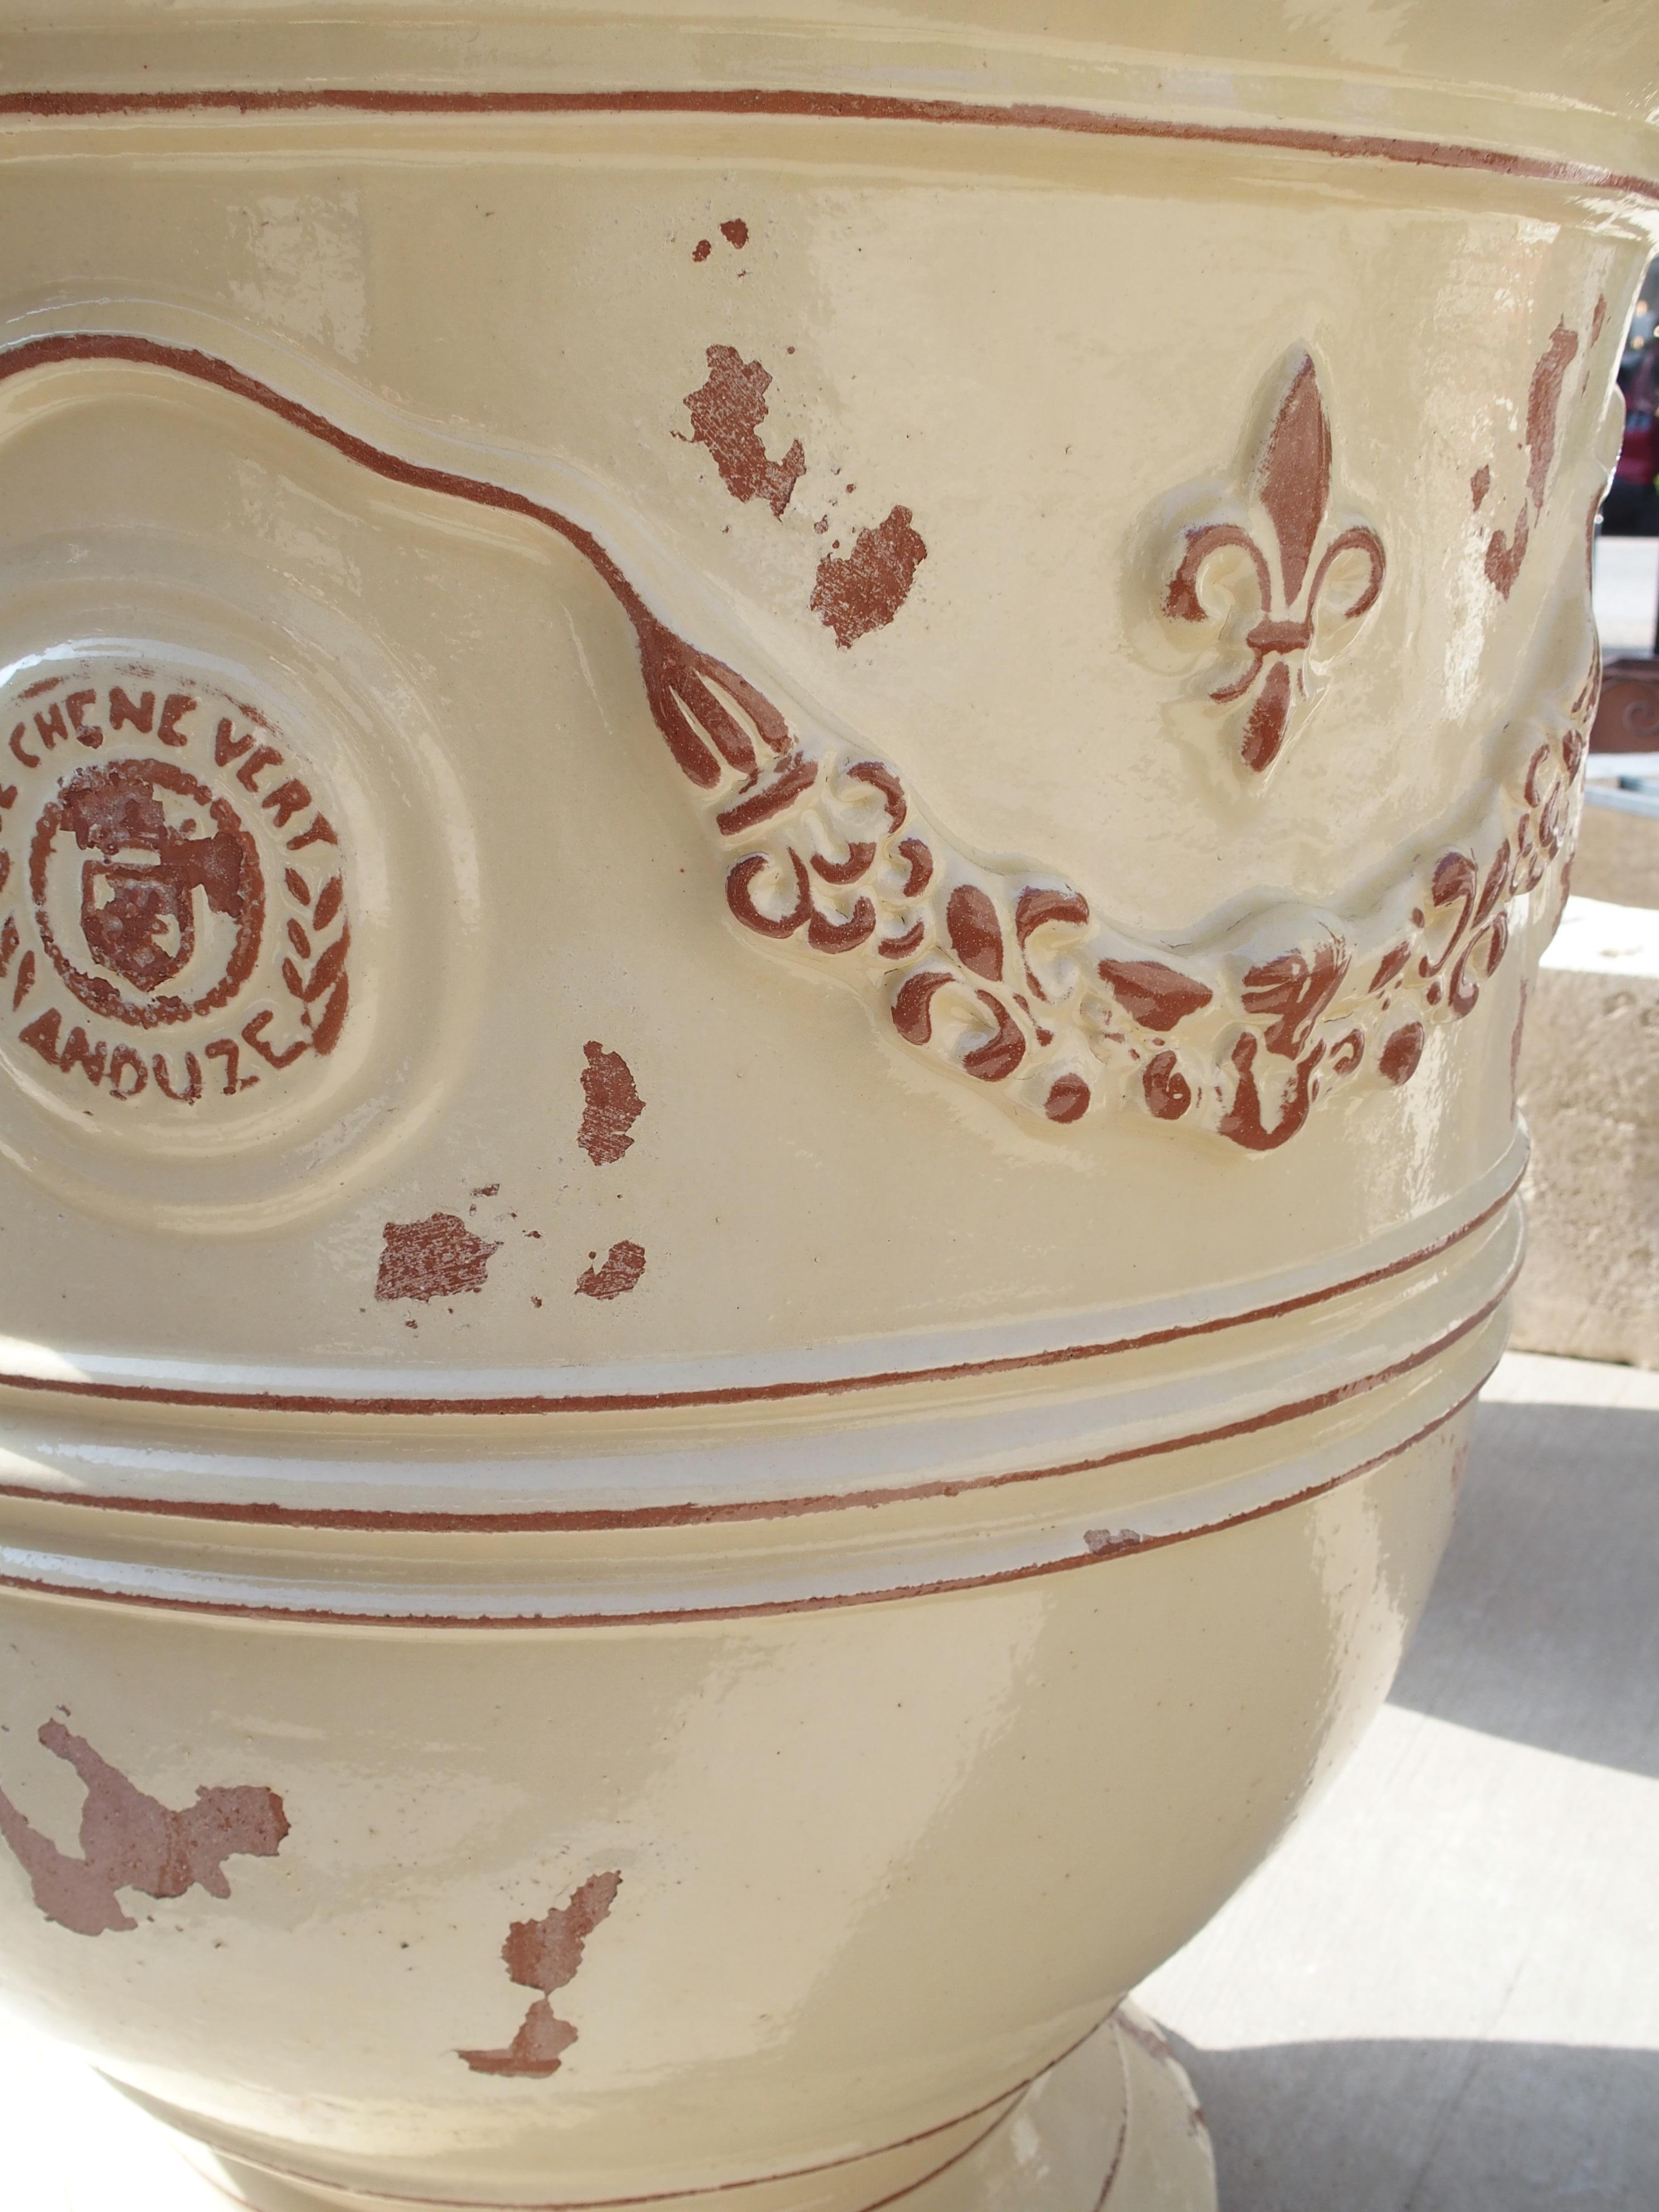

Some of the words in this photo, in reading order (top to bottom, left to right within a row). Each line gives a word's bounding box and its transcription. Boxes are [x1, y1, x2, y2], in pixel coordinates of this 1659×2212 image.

[9, 688, 198, 768] CHENE
[215, 717, 338, 851] VERT
[19, 1007, 311, 1103] ANDUZE
